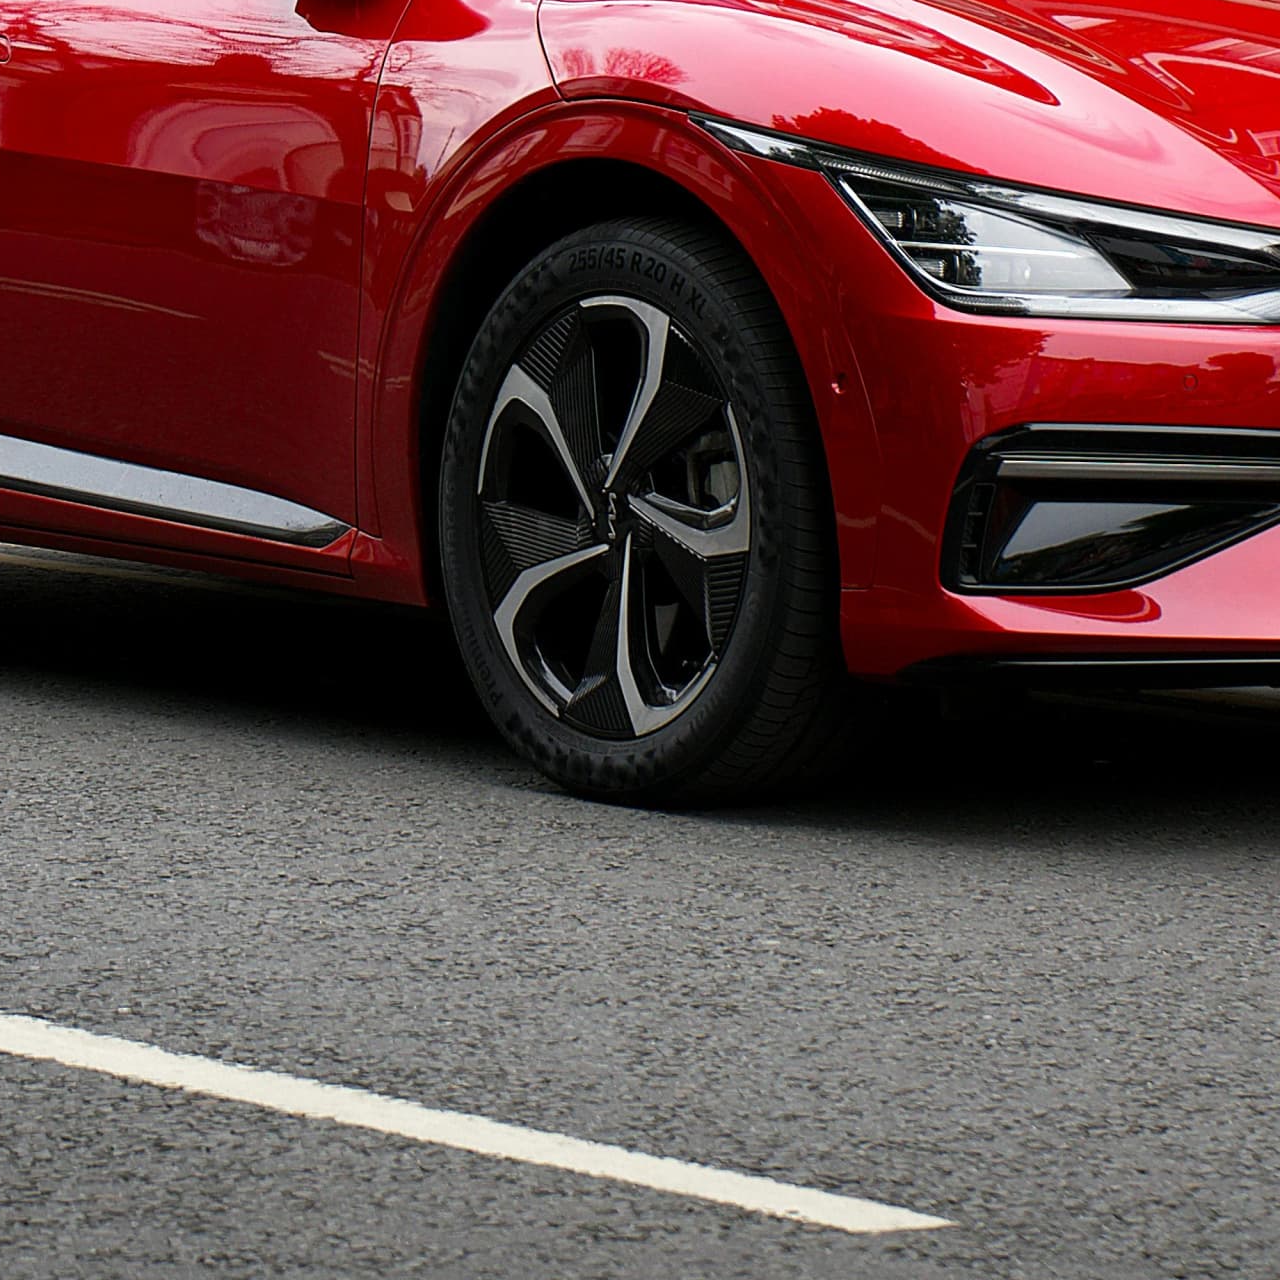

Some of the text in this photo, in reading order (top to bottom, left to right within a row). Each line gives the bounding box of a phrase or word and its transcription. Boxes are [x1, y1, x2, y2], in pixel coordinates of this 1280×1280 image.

[569, 245, 626, 274] 255/45
[670, 272, 685, 296] H
[686, 286, 707, 320] XL
